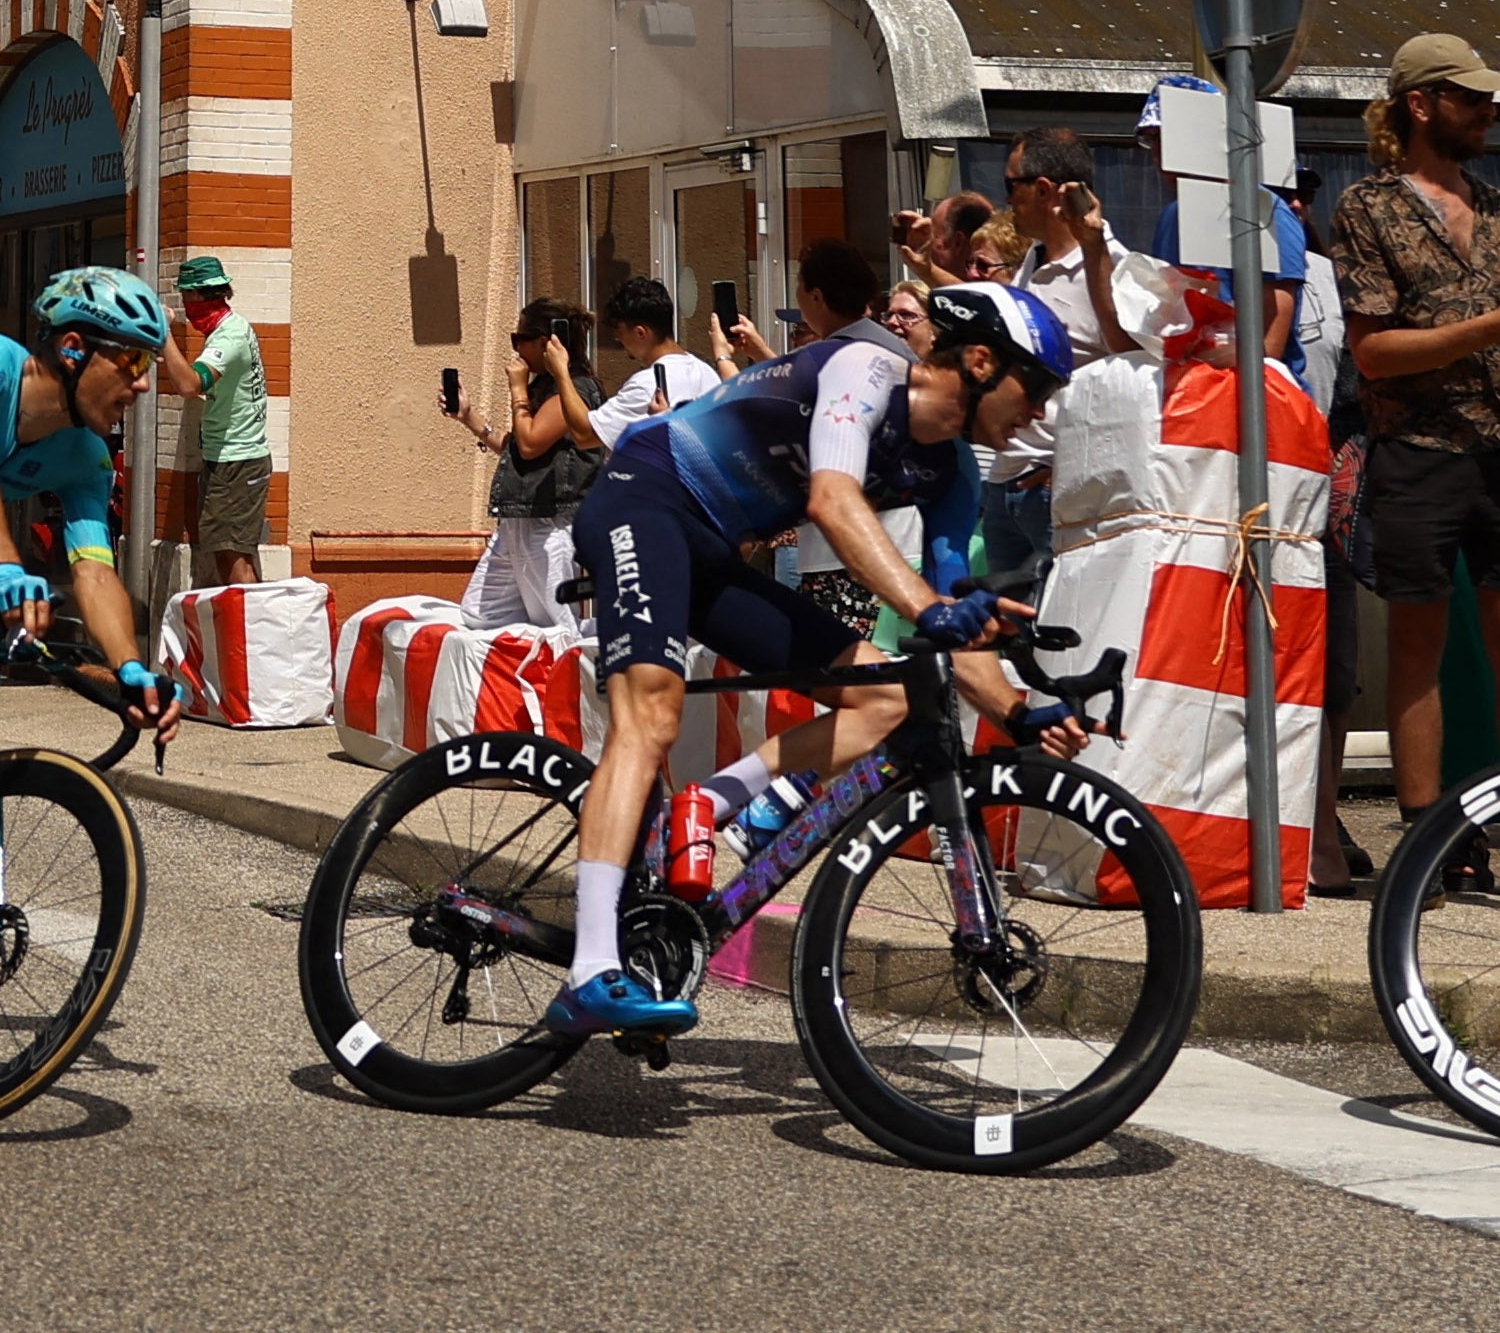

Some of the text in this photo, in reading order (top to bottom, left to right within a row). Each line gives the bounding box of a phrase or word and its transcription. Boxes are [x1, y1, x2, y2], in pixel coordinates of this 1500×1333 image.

[23, 77, 94, 145] Le Progrès
[24, 164, 67, 198] BRASSERIE
[92, 152, 125, 184] PIZZER
[737, 362, 793, 387] FACTOR
[609, 524, 641, 594] ISRAEL
[838, 764, 1142, 875] BLAK INC
[937, 826, 954, 870] FACTOR
[460, 905, 492, 923] OSTRO
